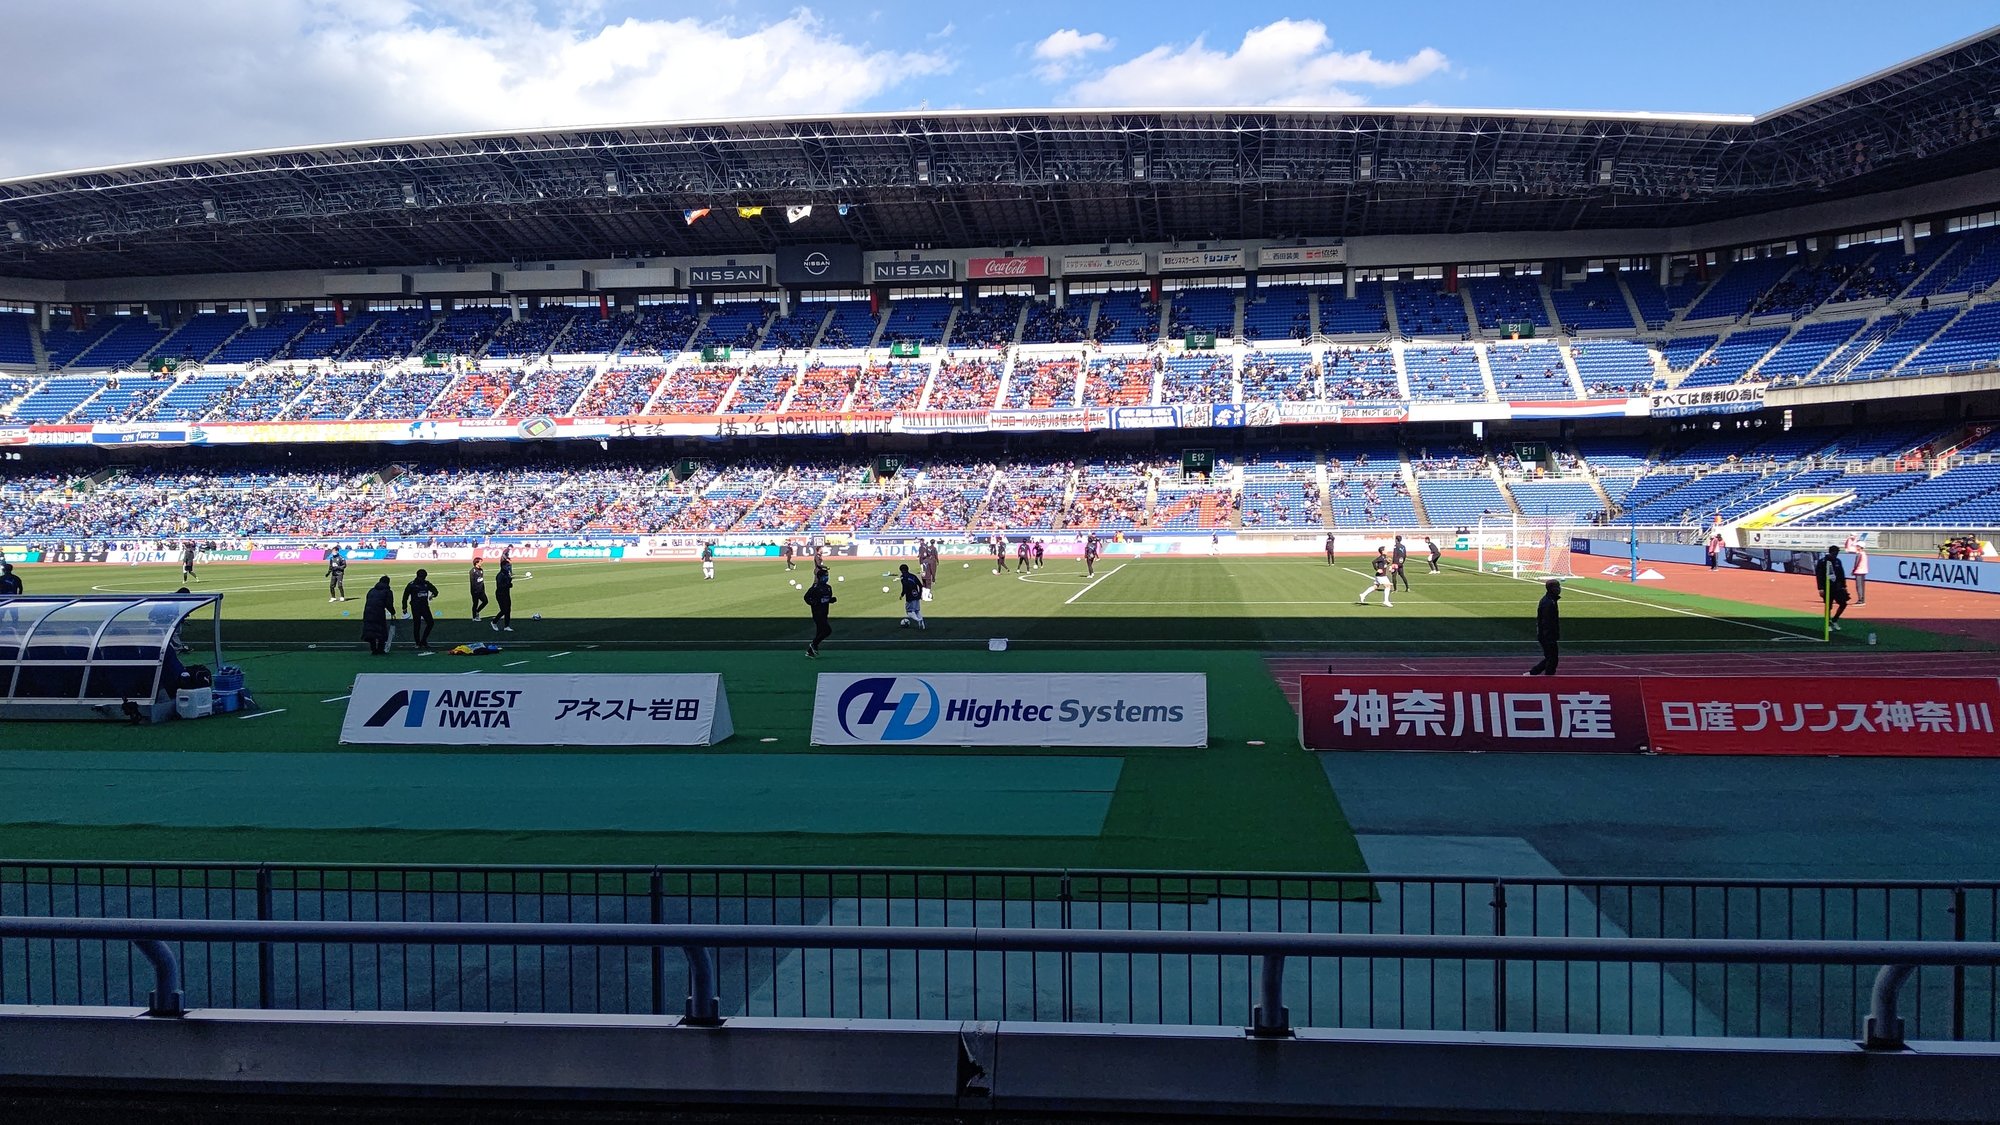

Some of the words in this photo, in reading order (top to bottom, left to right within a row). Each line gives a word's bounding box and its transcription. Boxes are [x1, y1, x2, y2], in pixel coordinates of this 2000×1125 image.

[692, 269, 761, 282] NISSAN
[877, 264, 947, 277] NISSAN
[1508, 324, 1521, 332] E21
[1651, 387, 1765, 408] すべては勝利の為に
[776, 416, 843, 435] FOREVER
[902, 412, 927, 426] PAINT
[942, 411, 988, 426] TRICOLORE
[1191, 453, 1205, 462] E12
[1522, 446, 1536, 455] E11
[689, 461, 701, 470] E14
[886, 458, 898, 467] E13
[482, 548, 539, 559] KOAMI
[1898, 560, 1979, 586] CARAVAN
[435, 690, 522, 707] ANEST
[554, 697, 700, 721] アネスト岩田
[945, 698, 1053, 728] Hightec
[1058, 699, 1184, 728] Systems
[1333, 688, 1616, 738] 神奈川日産
[1661, 700, 1994, 733] 日産プリンス神奈川
[439, 710, 511, 728] IWATA
